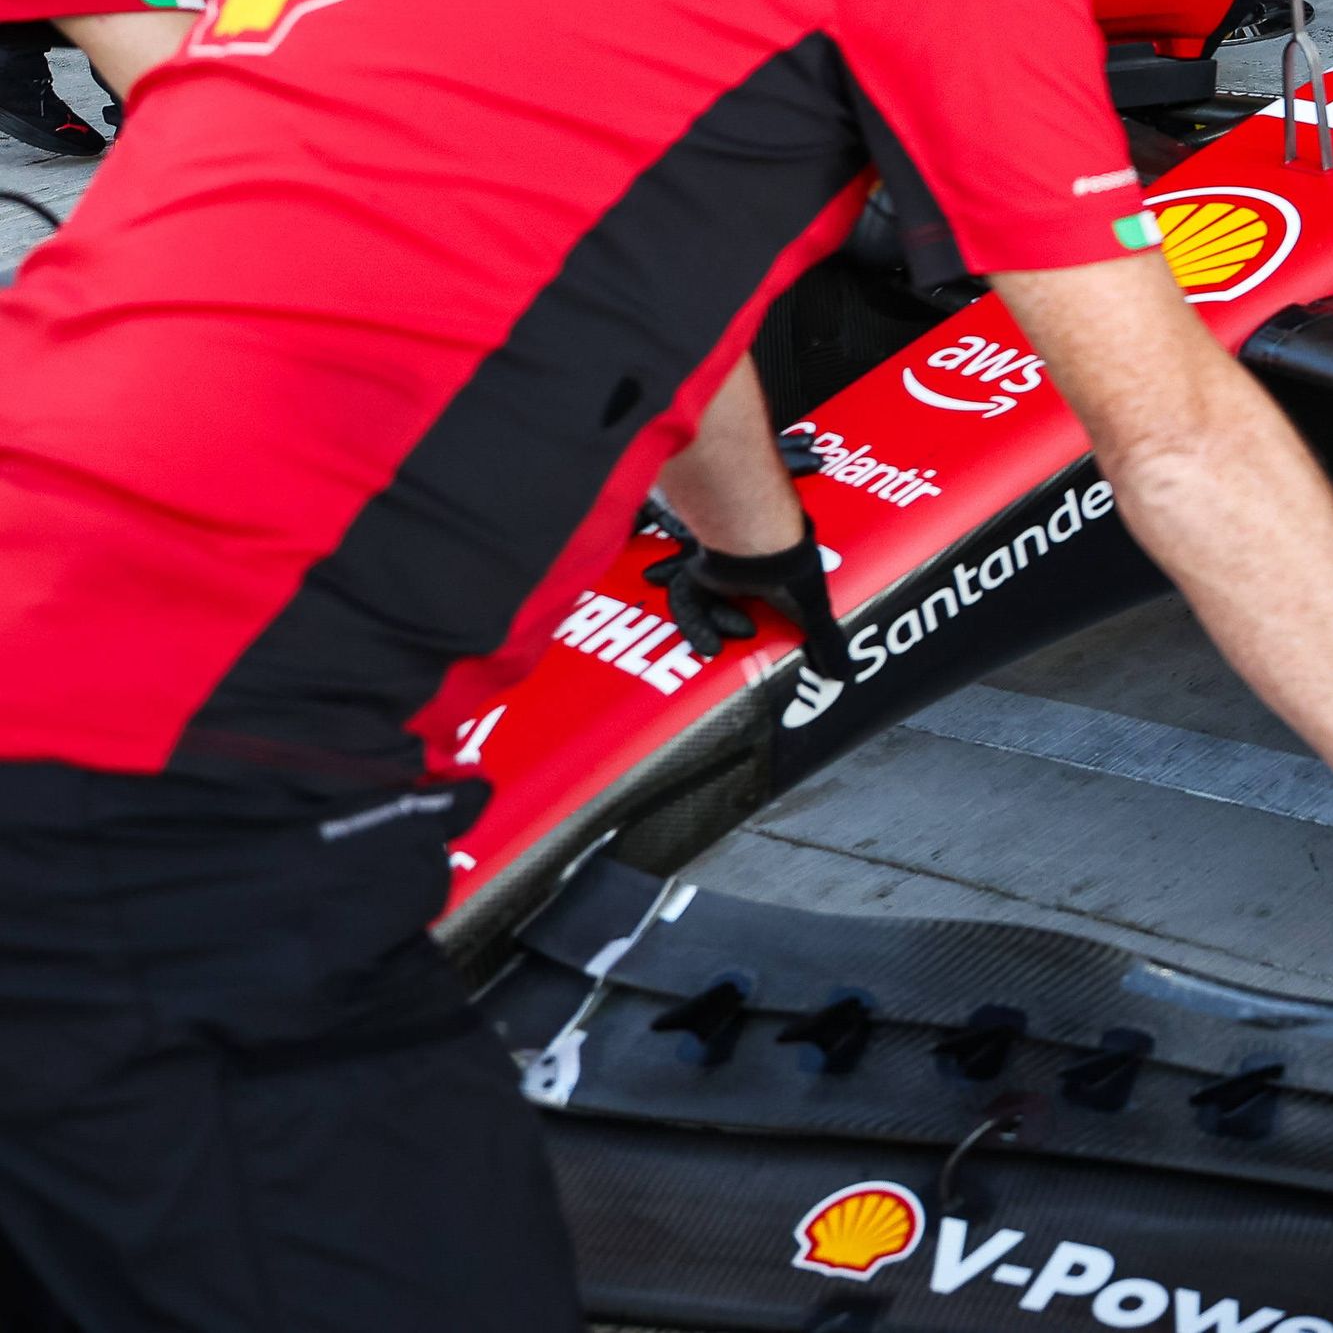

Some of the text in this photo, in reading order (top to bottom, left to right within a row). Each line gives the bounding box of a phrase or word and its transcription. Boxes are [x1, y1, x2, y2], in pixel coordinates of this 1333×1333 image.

[927, 335, 1043, 394] aws
[811, 431, 941, 507] Palantir
[848, 479, 1114, 684] Santande
[553, 590, 704, 697] AHLE
